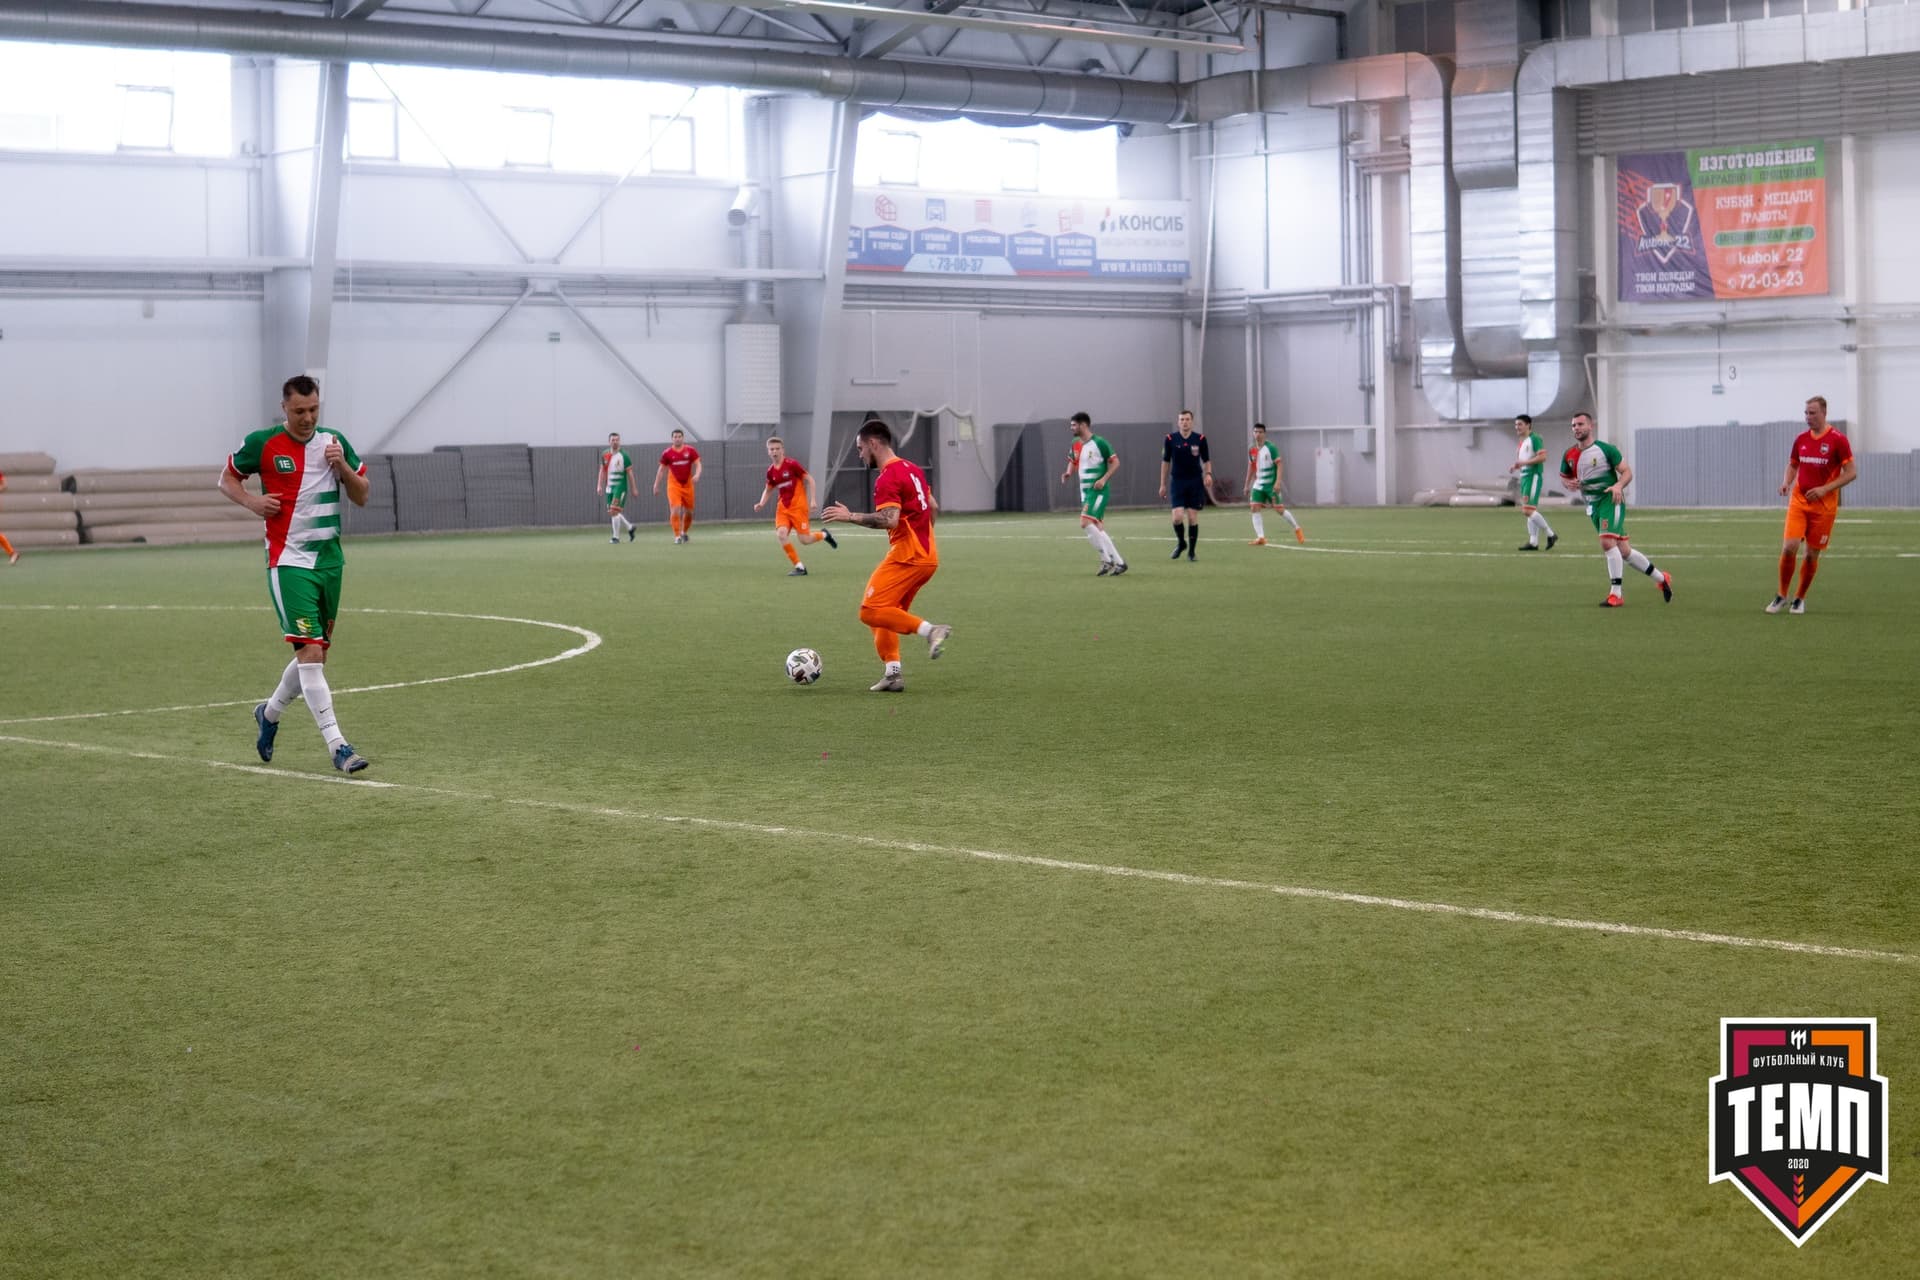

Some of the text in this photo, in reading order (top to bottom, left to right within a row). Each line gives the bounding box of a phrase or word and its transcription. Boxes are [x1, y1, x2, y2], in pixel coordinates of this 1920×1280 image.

[1699, 146, 1816, 172] ИЗГОТОВЛЕНИЕ
[1715, 189, 1813, 209] КУБКИ МЕДАЛИ
[1119, 215, 1184, 231] КОНСИБ
[1739, 270, 1804, 288] 72-03-23
[1728, 365, 1737, 380] 3
